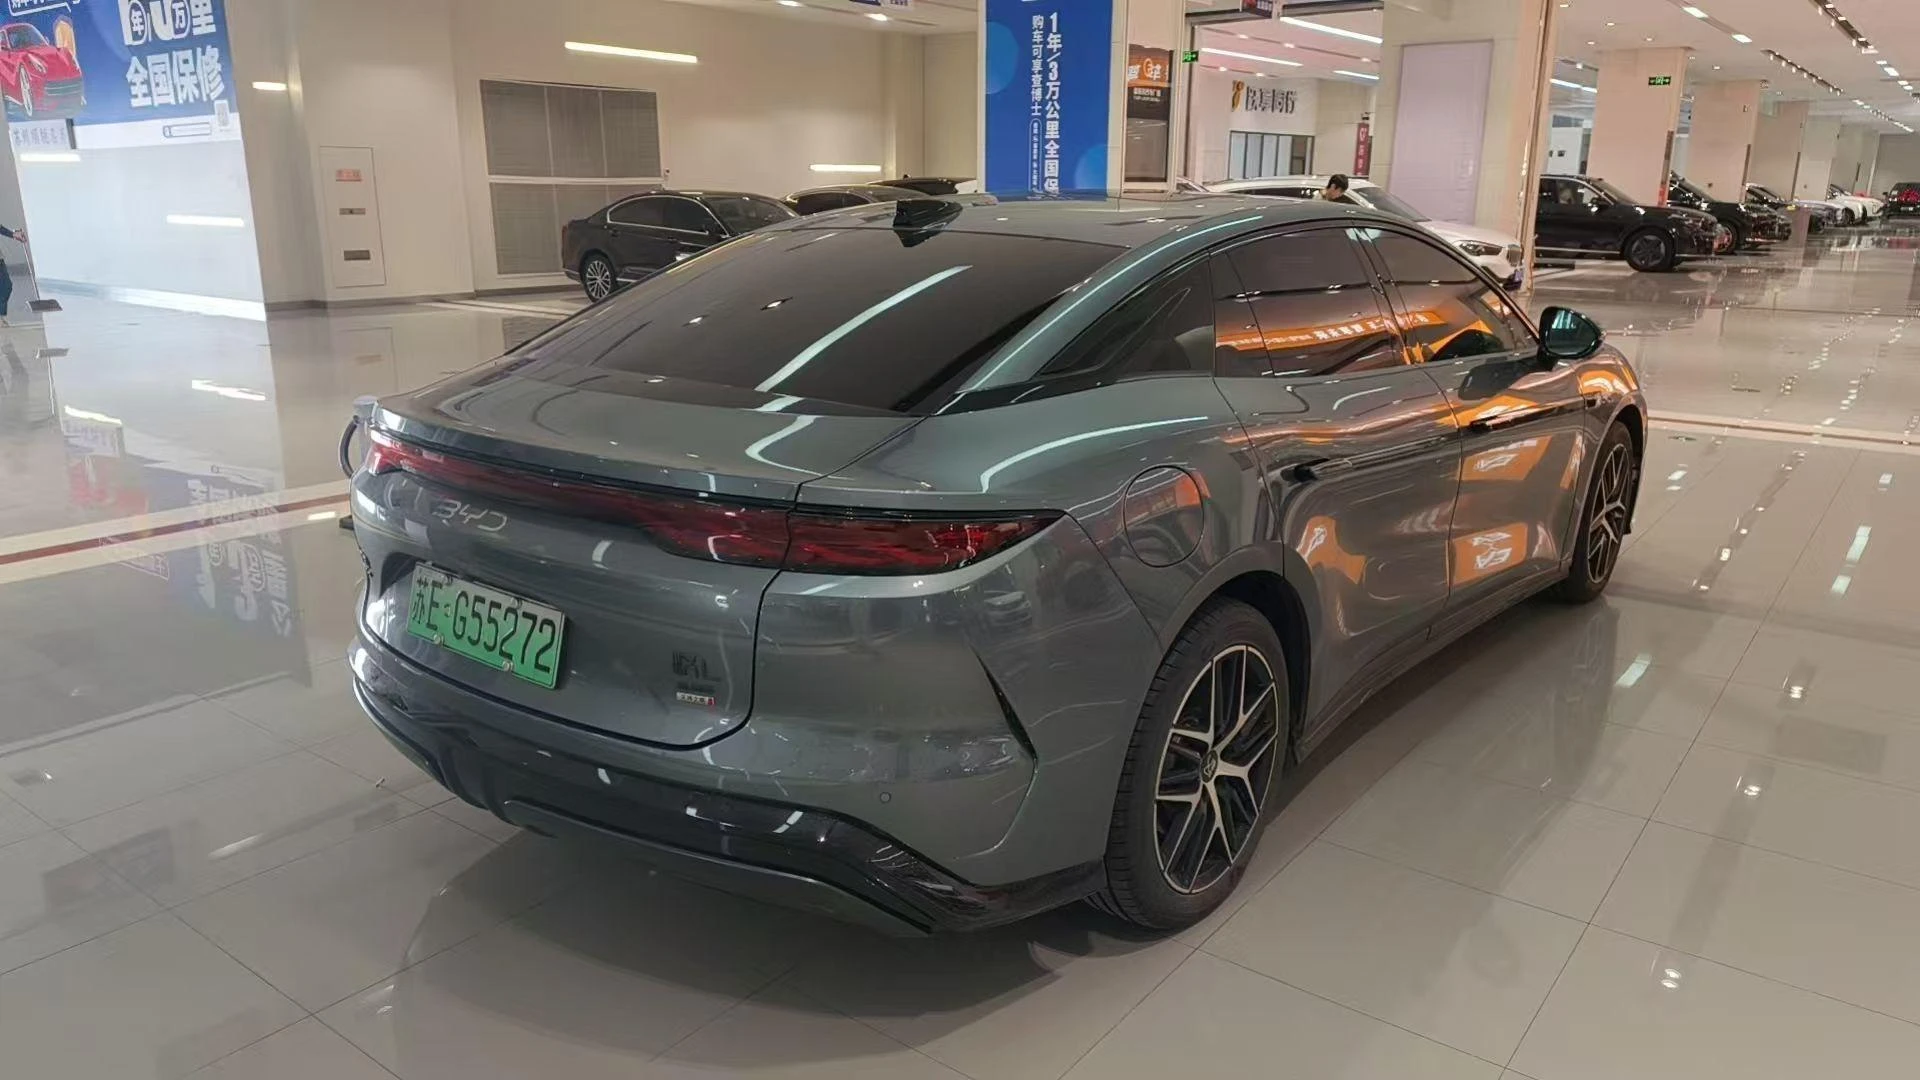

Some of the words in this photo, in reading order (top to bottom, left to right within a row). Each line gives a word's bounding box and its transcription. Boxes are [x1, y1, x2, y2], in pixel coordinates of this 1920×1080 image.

[126, 44, 225, 108] 全国保修
[1031, 15, 1044, 116] 购车可享查博士
[431, 498, 507, 532] BYD
